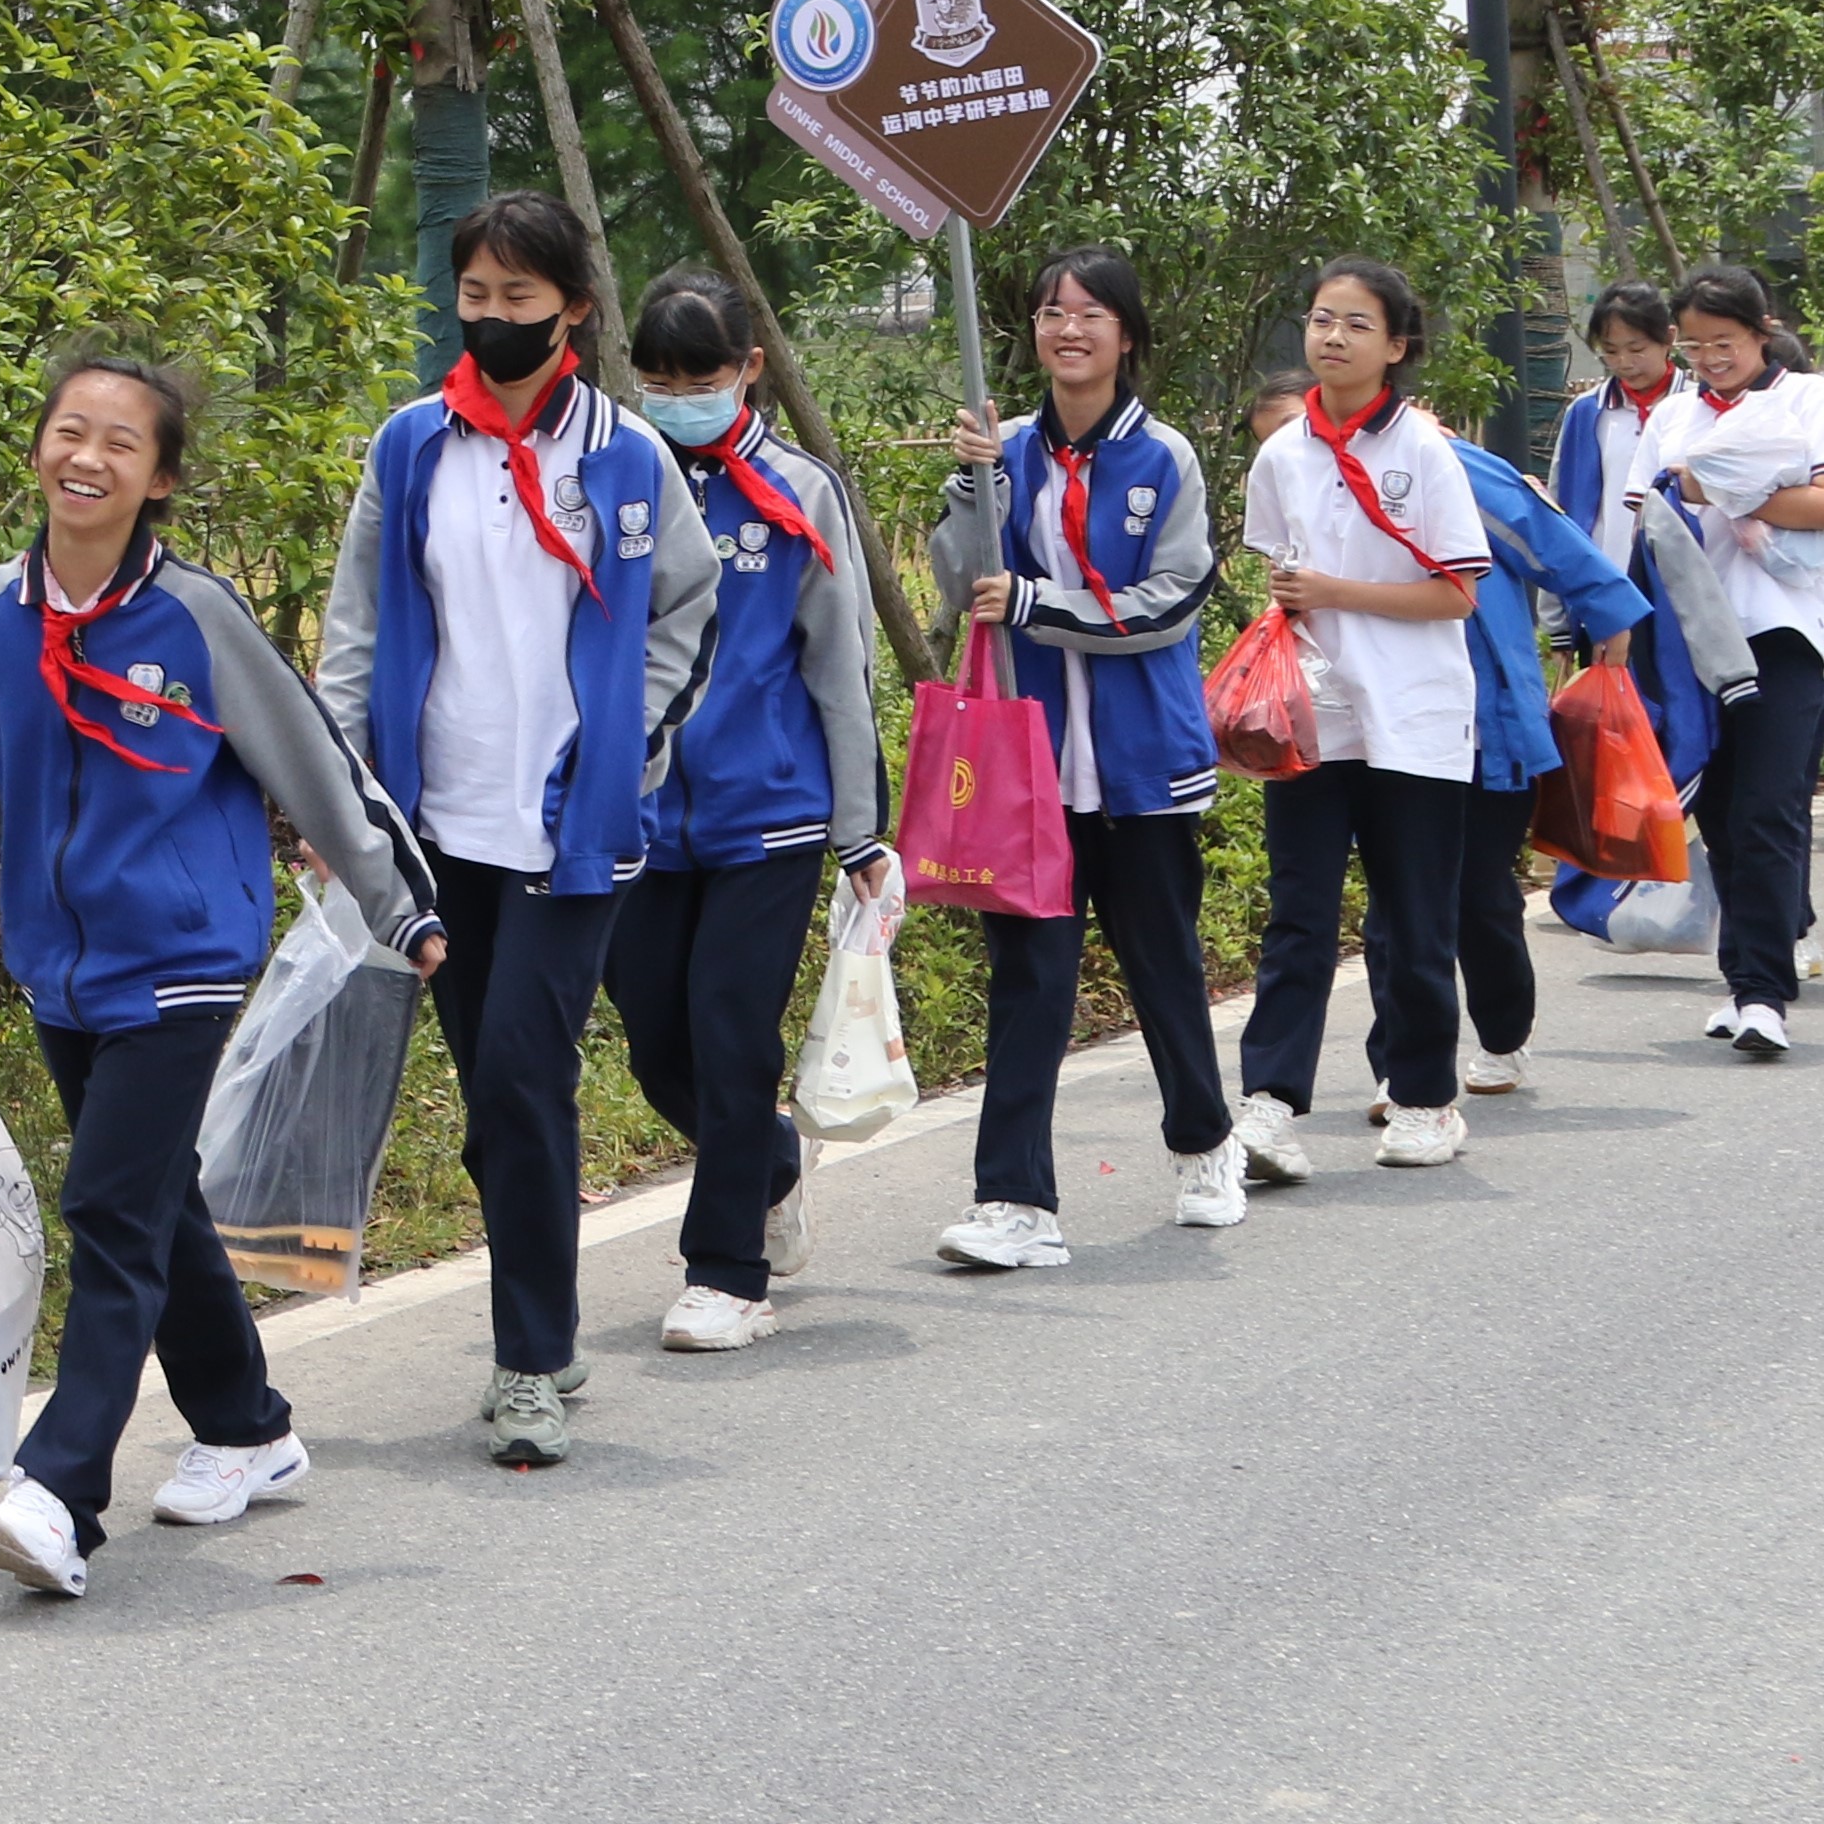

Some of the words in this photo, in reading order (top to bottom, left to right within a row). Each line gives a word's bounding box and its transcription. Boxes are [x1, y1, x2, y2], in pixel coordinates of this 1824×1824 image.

[899, 66, 1025, 105] 爷爷的水稻田
[881, 88, 1051, 135] 运河中学研学基地
[777, 91, 821, 139] YUNHE
[823, 133, 875, 183] MIDDLE
[876, 178, 932, 231] SCHOOL
